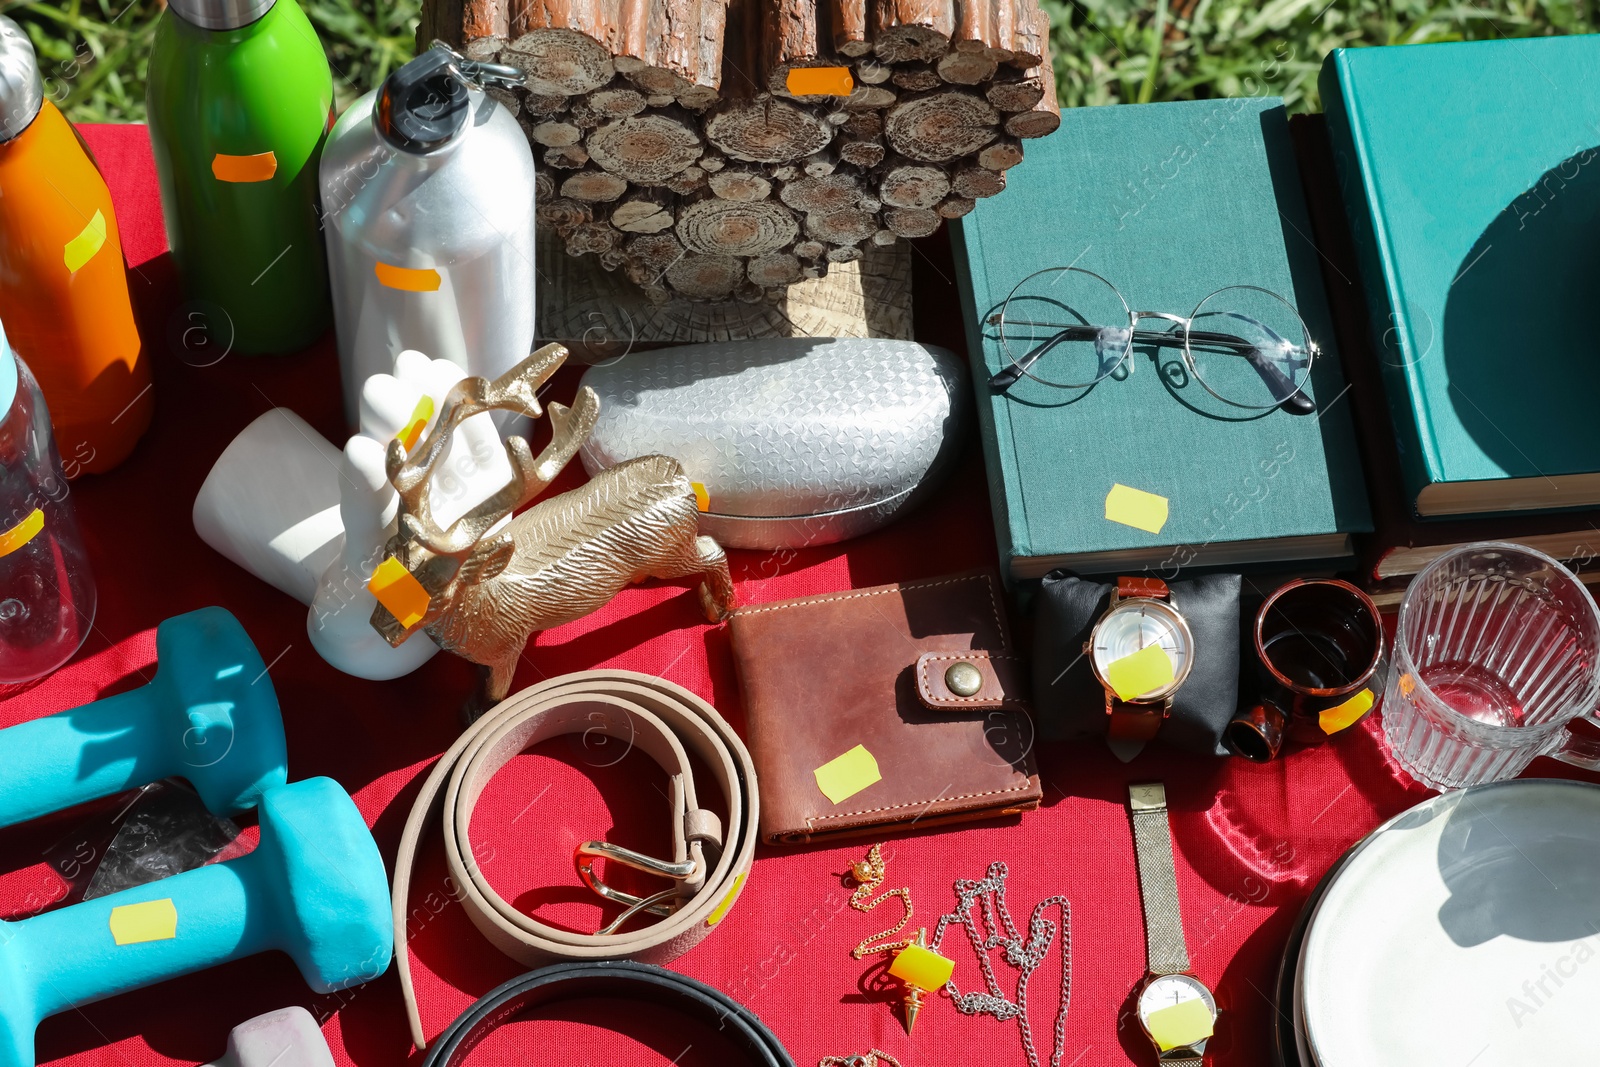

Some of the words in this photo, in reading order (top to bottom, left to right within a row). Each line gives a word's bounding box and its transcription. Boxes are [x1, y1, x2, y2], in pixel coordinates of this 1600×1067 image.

[497, 1001, 525, 1021] MADE
[487, 1018, 497, 1028] IN
[464, 1026, 486, 1050] CHINA
